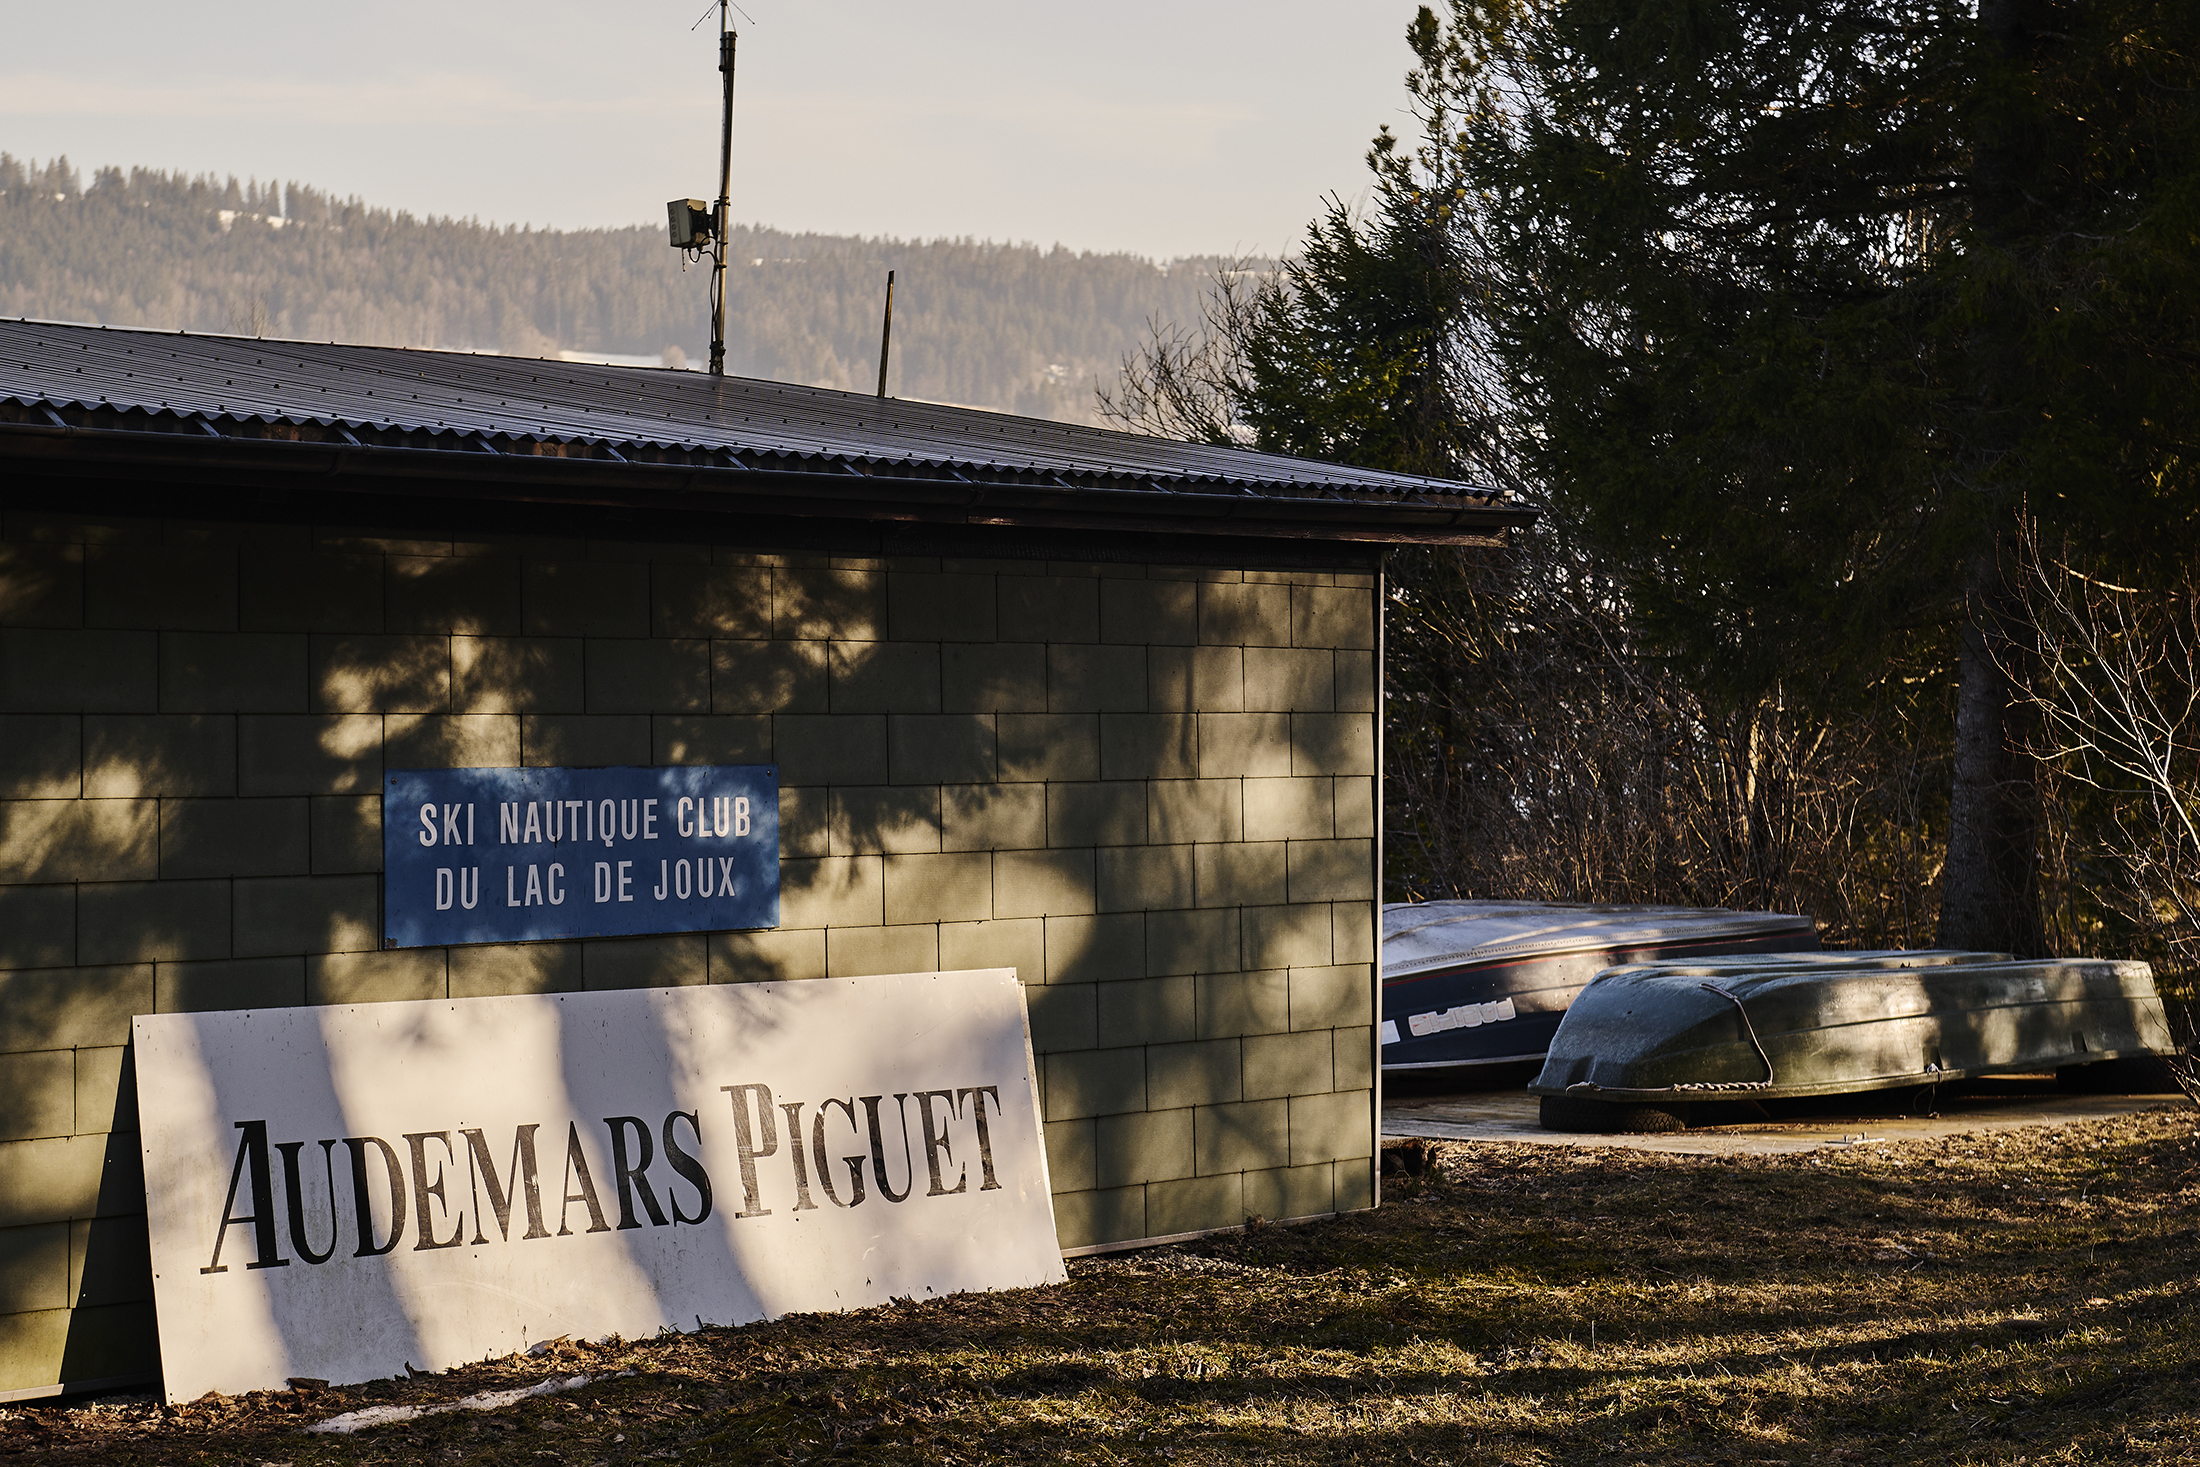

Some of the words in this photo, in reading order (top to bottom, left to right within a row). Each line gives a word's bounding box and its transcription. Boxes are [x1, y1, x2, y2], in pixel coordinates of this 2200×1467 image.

[419, 802, 475, 847] SKI
[500, 798, 659, 848] NAUTIQUE
[677, 796, 751, 838] CLUB
[436, 866, 479, 910] DU
[507, 862, 565, 907] LAC
[595, 860, 634, 903] DE
[654, 856, 735, 900] JOUX
[199, 1109, 714, 1275] AUDEMARS
[720, 1082, 1002, 1219] PIGUET
